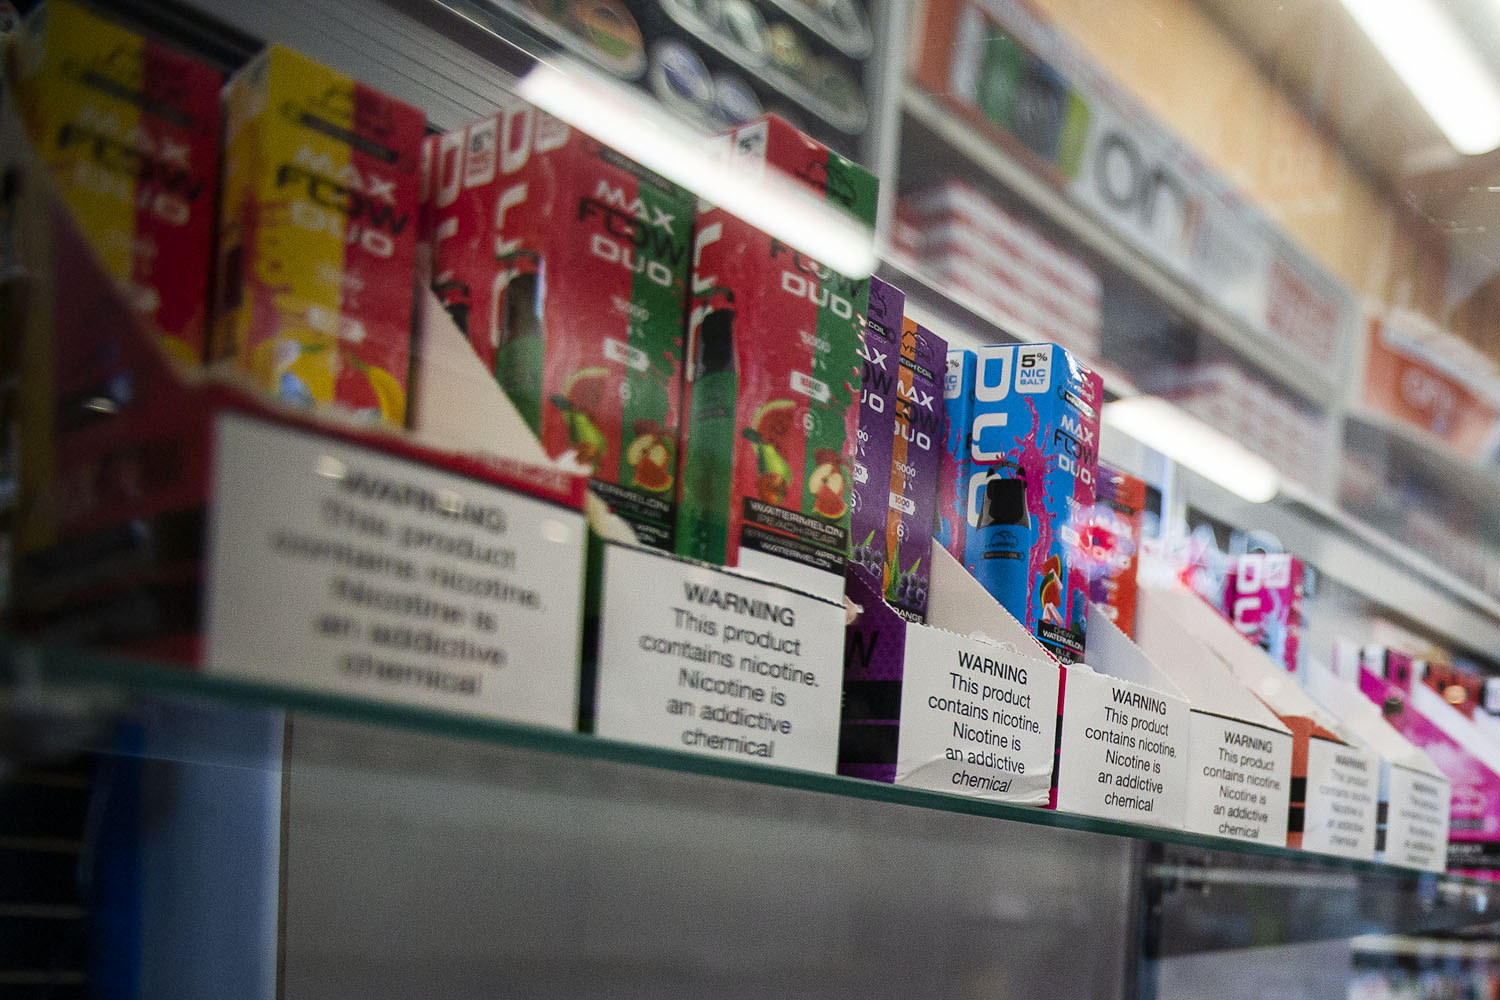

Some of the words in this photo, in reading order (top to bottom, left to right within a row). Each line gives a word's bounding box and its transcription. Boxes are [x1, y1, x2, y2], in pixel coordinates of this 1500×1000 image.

[595, 181, 676, 235] MAX
[578, 196, 688, 267] FLOW
[590, 234, 674, 287] DUO
[781, 271, 852, 320] DUO
[1020, 369, 1046, 379] NIC
[1021, 352, 1048, 368] 5%
[862, 362, 892, 395] OW
[944, 374, 957, 384] IC
[1020, 378, 1045, 386] SALT
[896, 397, 939, 433] OW
[1060, 414, 1094, 447] MAX
[1054, 429, 1097, 467] FLOW
[1058, 454, 1091, 484] DUO
[751, 503, 845, 539] WATERMELON
[683, 580, 795, 626] WARNING
[671, 607, 716, 636] This
[723, 624, 801, 656] product
[1042, 630, 1083, 651] WATERMELON
[639, 634, 734, 669] contains
[740, 656, 819, 687] nicotine.
[958, 650, 1027, 685] WARNING
[678, 668, 764, 703] Nicotine
[770, 686, 786, 707] is
[950, 672, 978, 695] This
[983, 683, 1031, 709] product
[1111, 688, 1166, 715] WARNING
[667, 698, 696, 716] an
[700, 704, 792, 735] addictive
[928, 695, 988, 721] contains
[992, 709, 1042, 735] nicotine.
[1104, 706, 1128, 725] This
[1130, 715, 1168, 736] product
[682, 728, 775, 758] chemical
[953, 722, 1007, 749] Nicotine
[1011, 735, 1021, 751] is
[1085, 726, 1135, 748] contains
[1138, 737, 1177, 758] nicotine.
[1224, 730, 1273, 753] WARNING
[946, 747, 963, 762] an
[967, 749, 1025, 774] addictive
[1105, 749, 1150, 771] Nicotine
[1152, 760, 1161, 773] is
[1203, 765, 1244, 783] contains
[1219, 747, 1238, 763] This
[1241, 756, 1274, 772] product
[951, 770, 1012, 794] chemical
[1098, 771, 1113, 784] an
[1115, 773, 1163, 794] addictive
[1220, 785, 1257, 803] Nicotine
[1260, 794, 1266, 805] is
[1104, 793, 1154, 812] chemical
[1213, 804, 1226, 815] an
[1227, 806, 1268, 823] addictive
[1218, 823, 1260, 839] chemical
